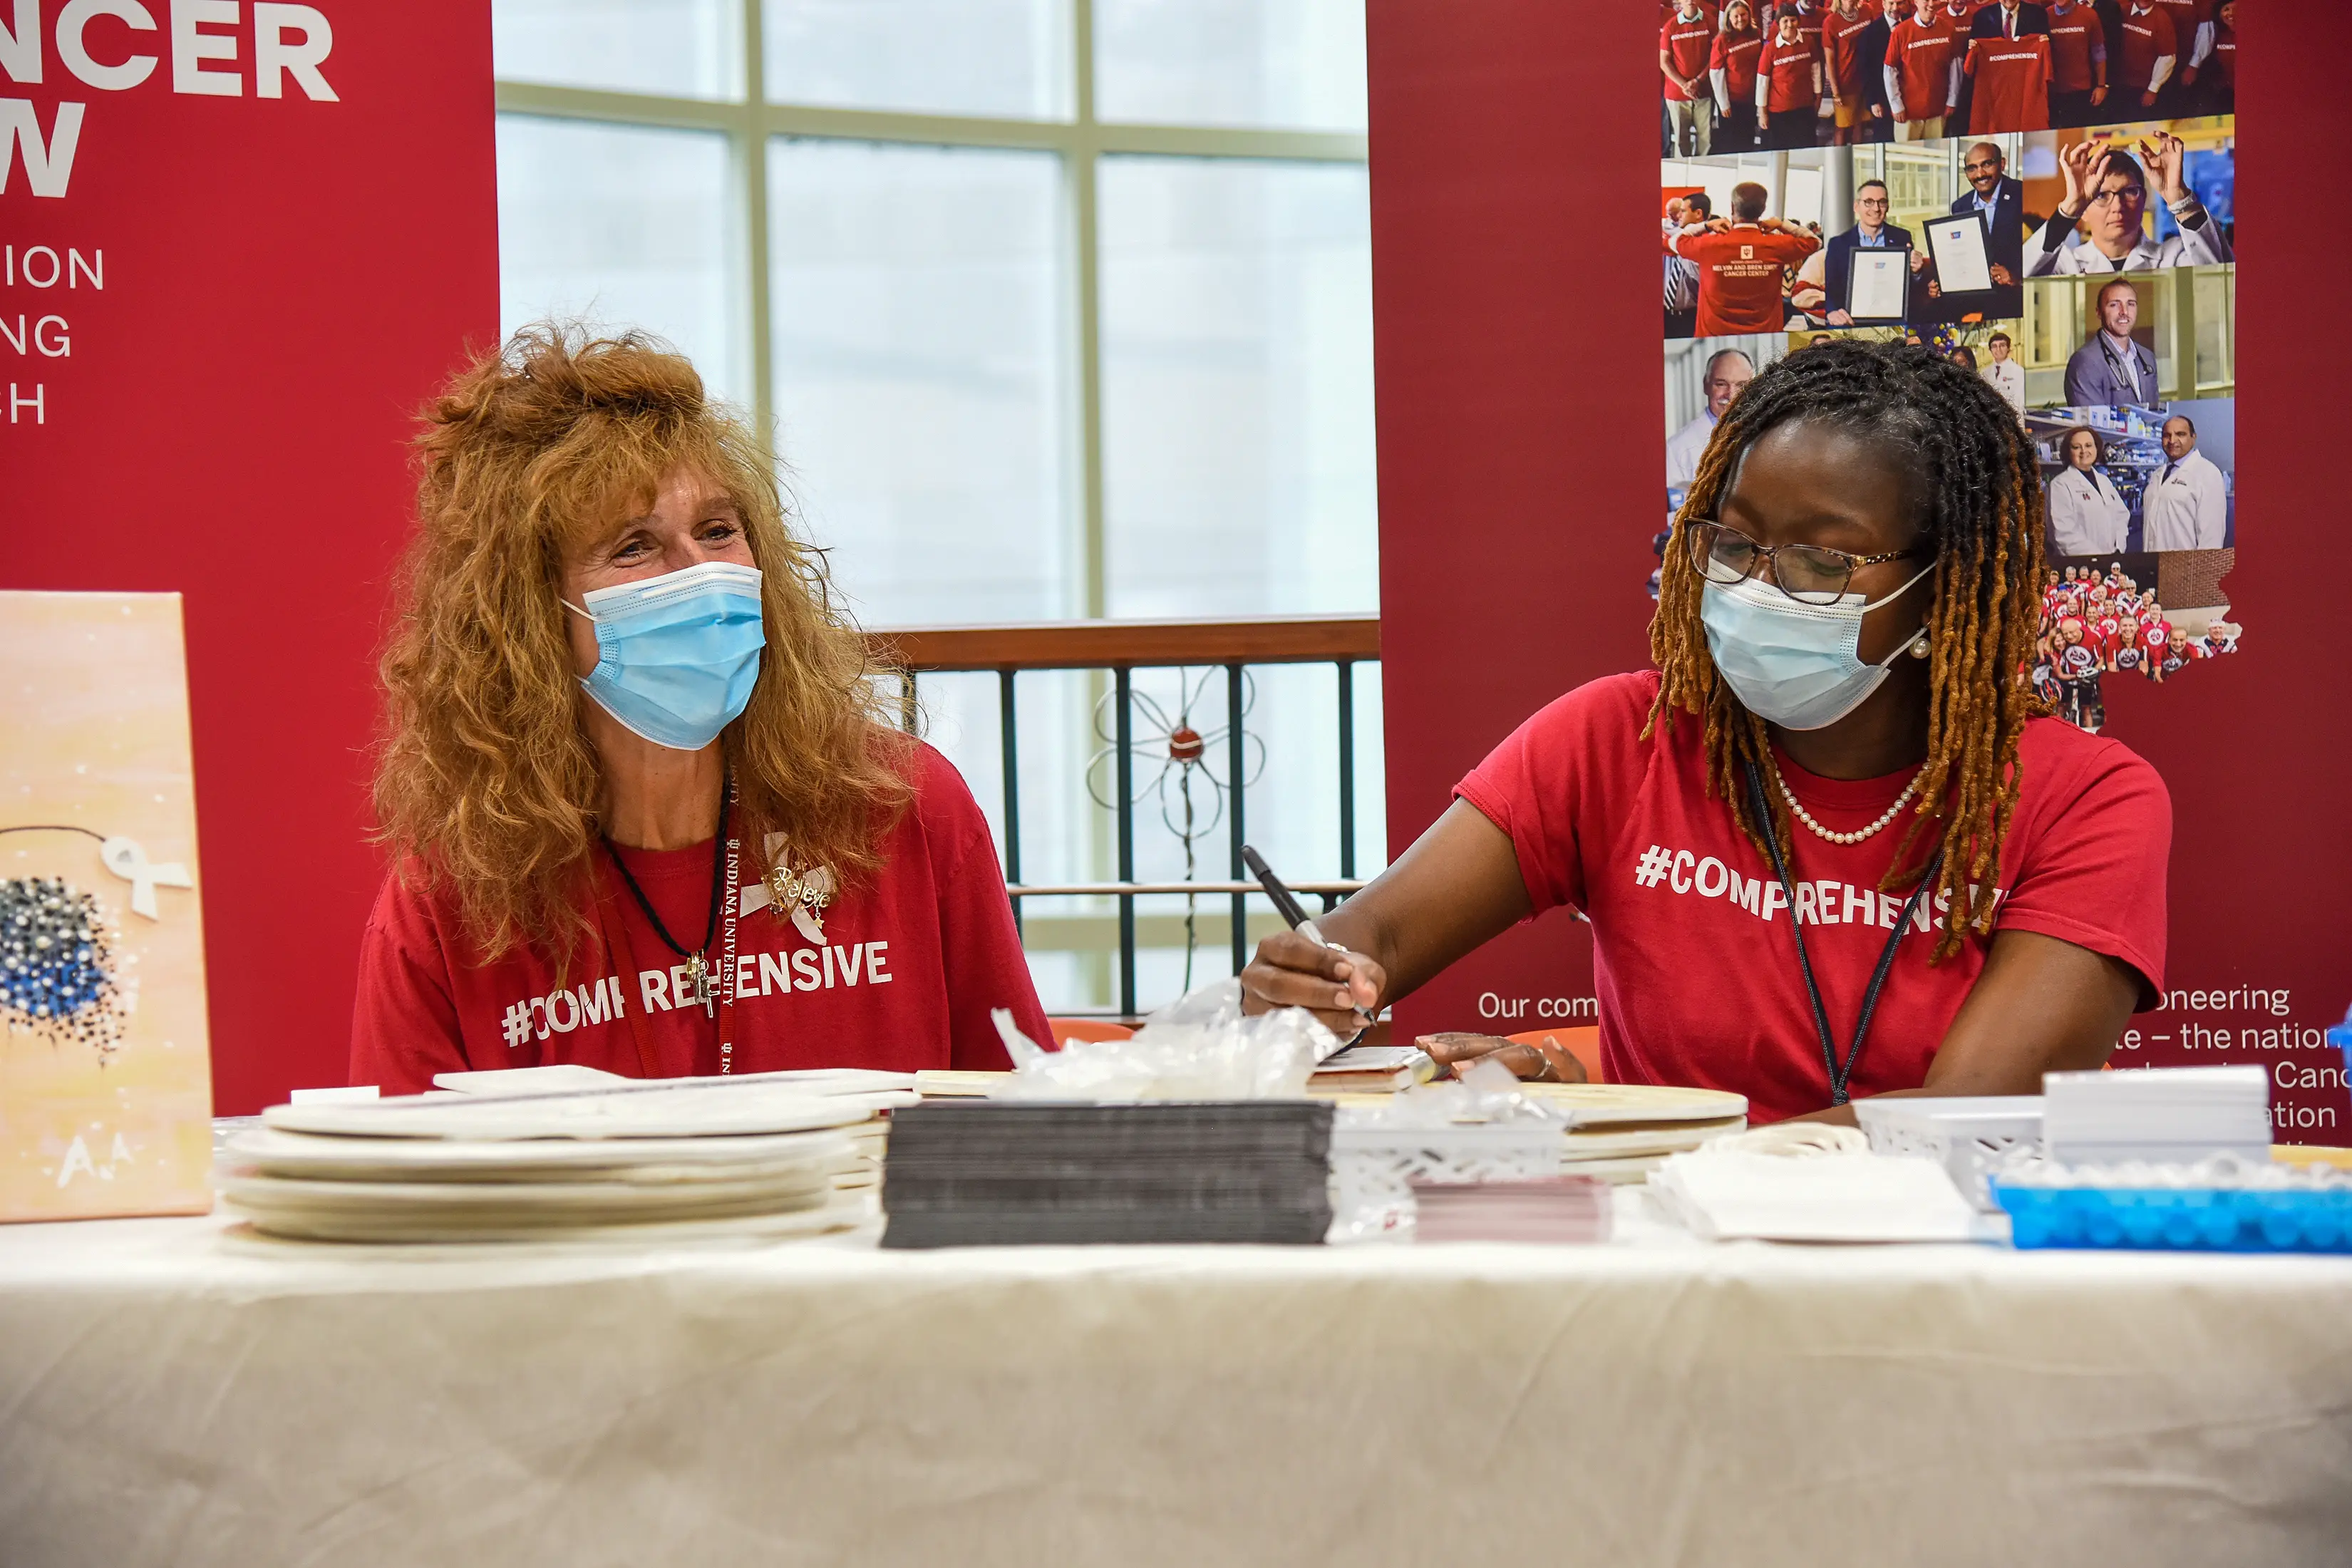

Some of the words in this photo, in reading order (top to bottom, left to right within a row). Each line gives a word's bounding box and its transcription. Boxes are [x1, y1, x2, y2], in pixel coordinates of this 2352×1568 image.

[0, 0, 340, 102] NCER
[1989, 52, 2038, 63] #COMPREHENSIVE
[6, 245, 104, 291] ION
[0, 314, 71, 358] NG
[0, 382, 44, 425] H
[725, 852, 739, 916] INDIANA
[1635, 845, 2010, 935] #COMPREHENS
[722, 917, 737, 1007] UNIVERSITY
[1478, 991, 1531, 1018] Our
[1537, 998, 1599, 1018] com
[2180, 1022, 2232, 1050] the
